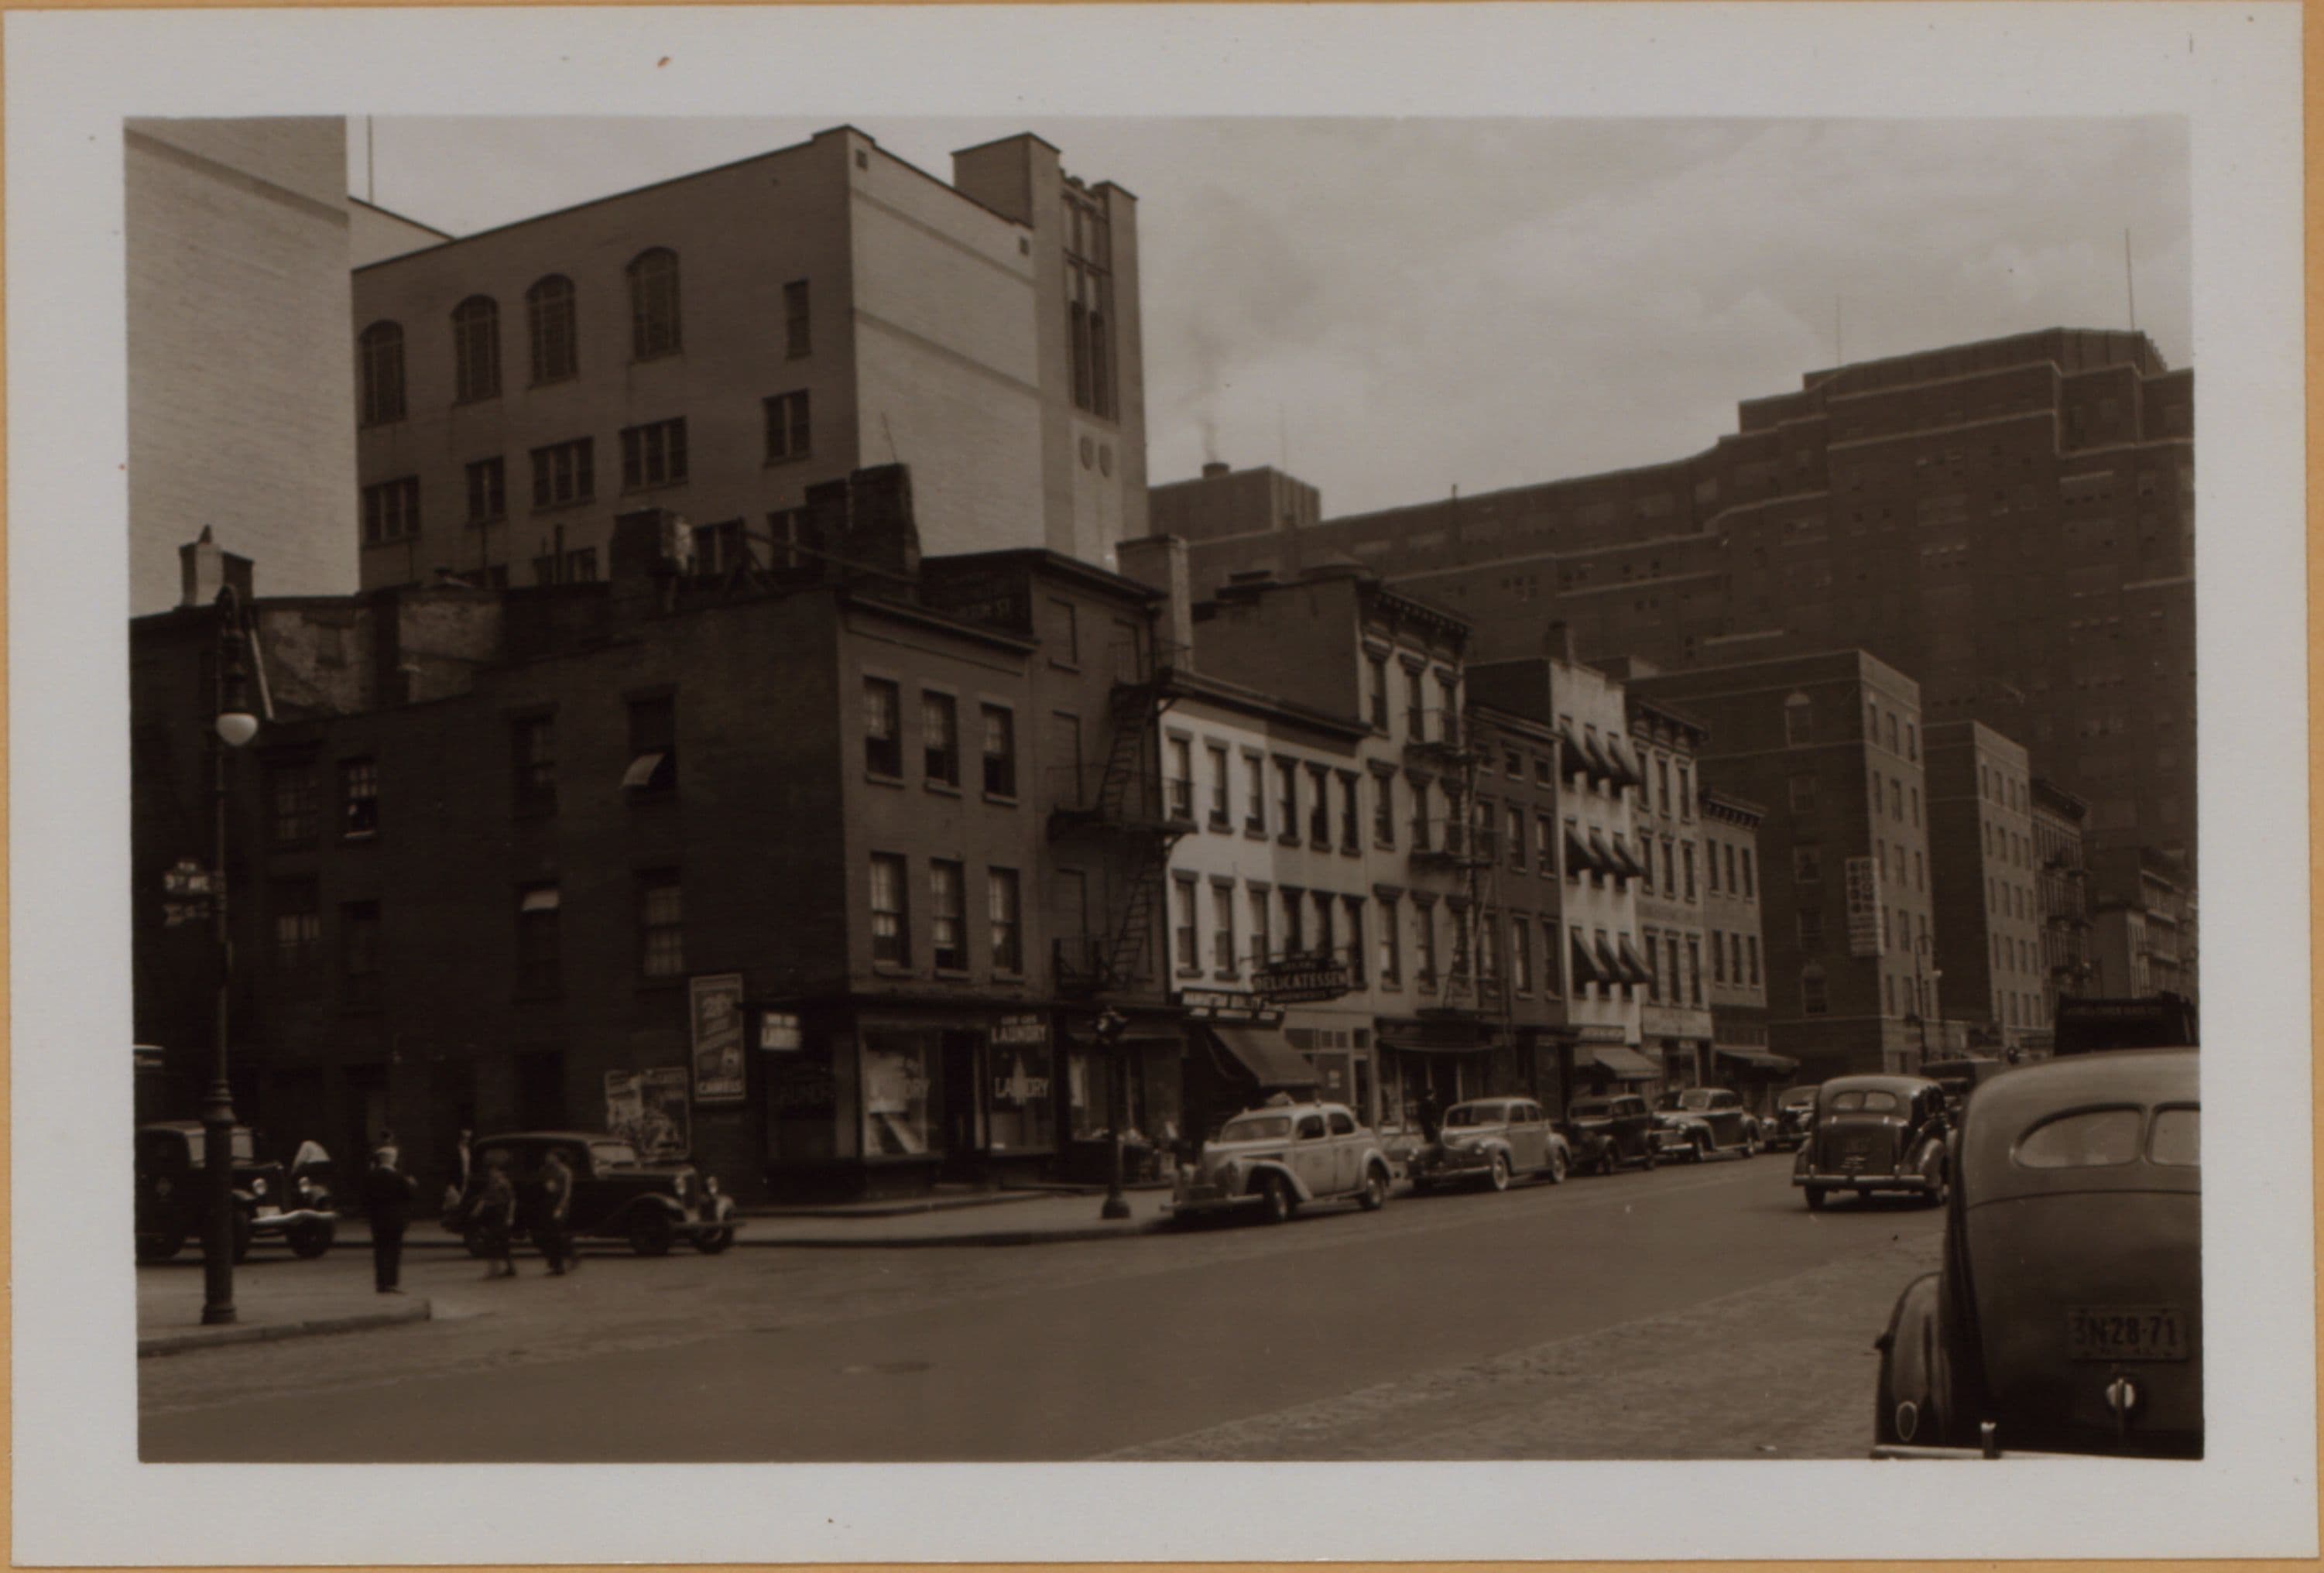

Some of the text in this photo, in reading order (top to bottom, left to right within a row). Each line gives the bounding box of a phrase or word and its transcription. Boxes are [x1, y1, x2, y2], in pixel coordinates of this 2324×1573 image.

[1252, 970, 1349, 993] DELICATESSEN
[991, 1023, 1047, 1044] LAUNDRY
[2073, 1316, 2177, 1346] 3N28-71
